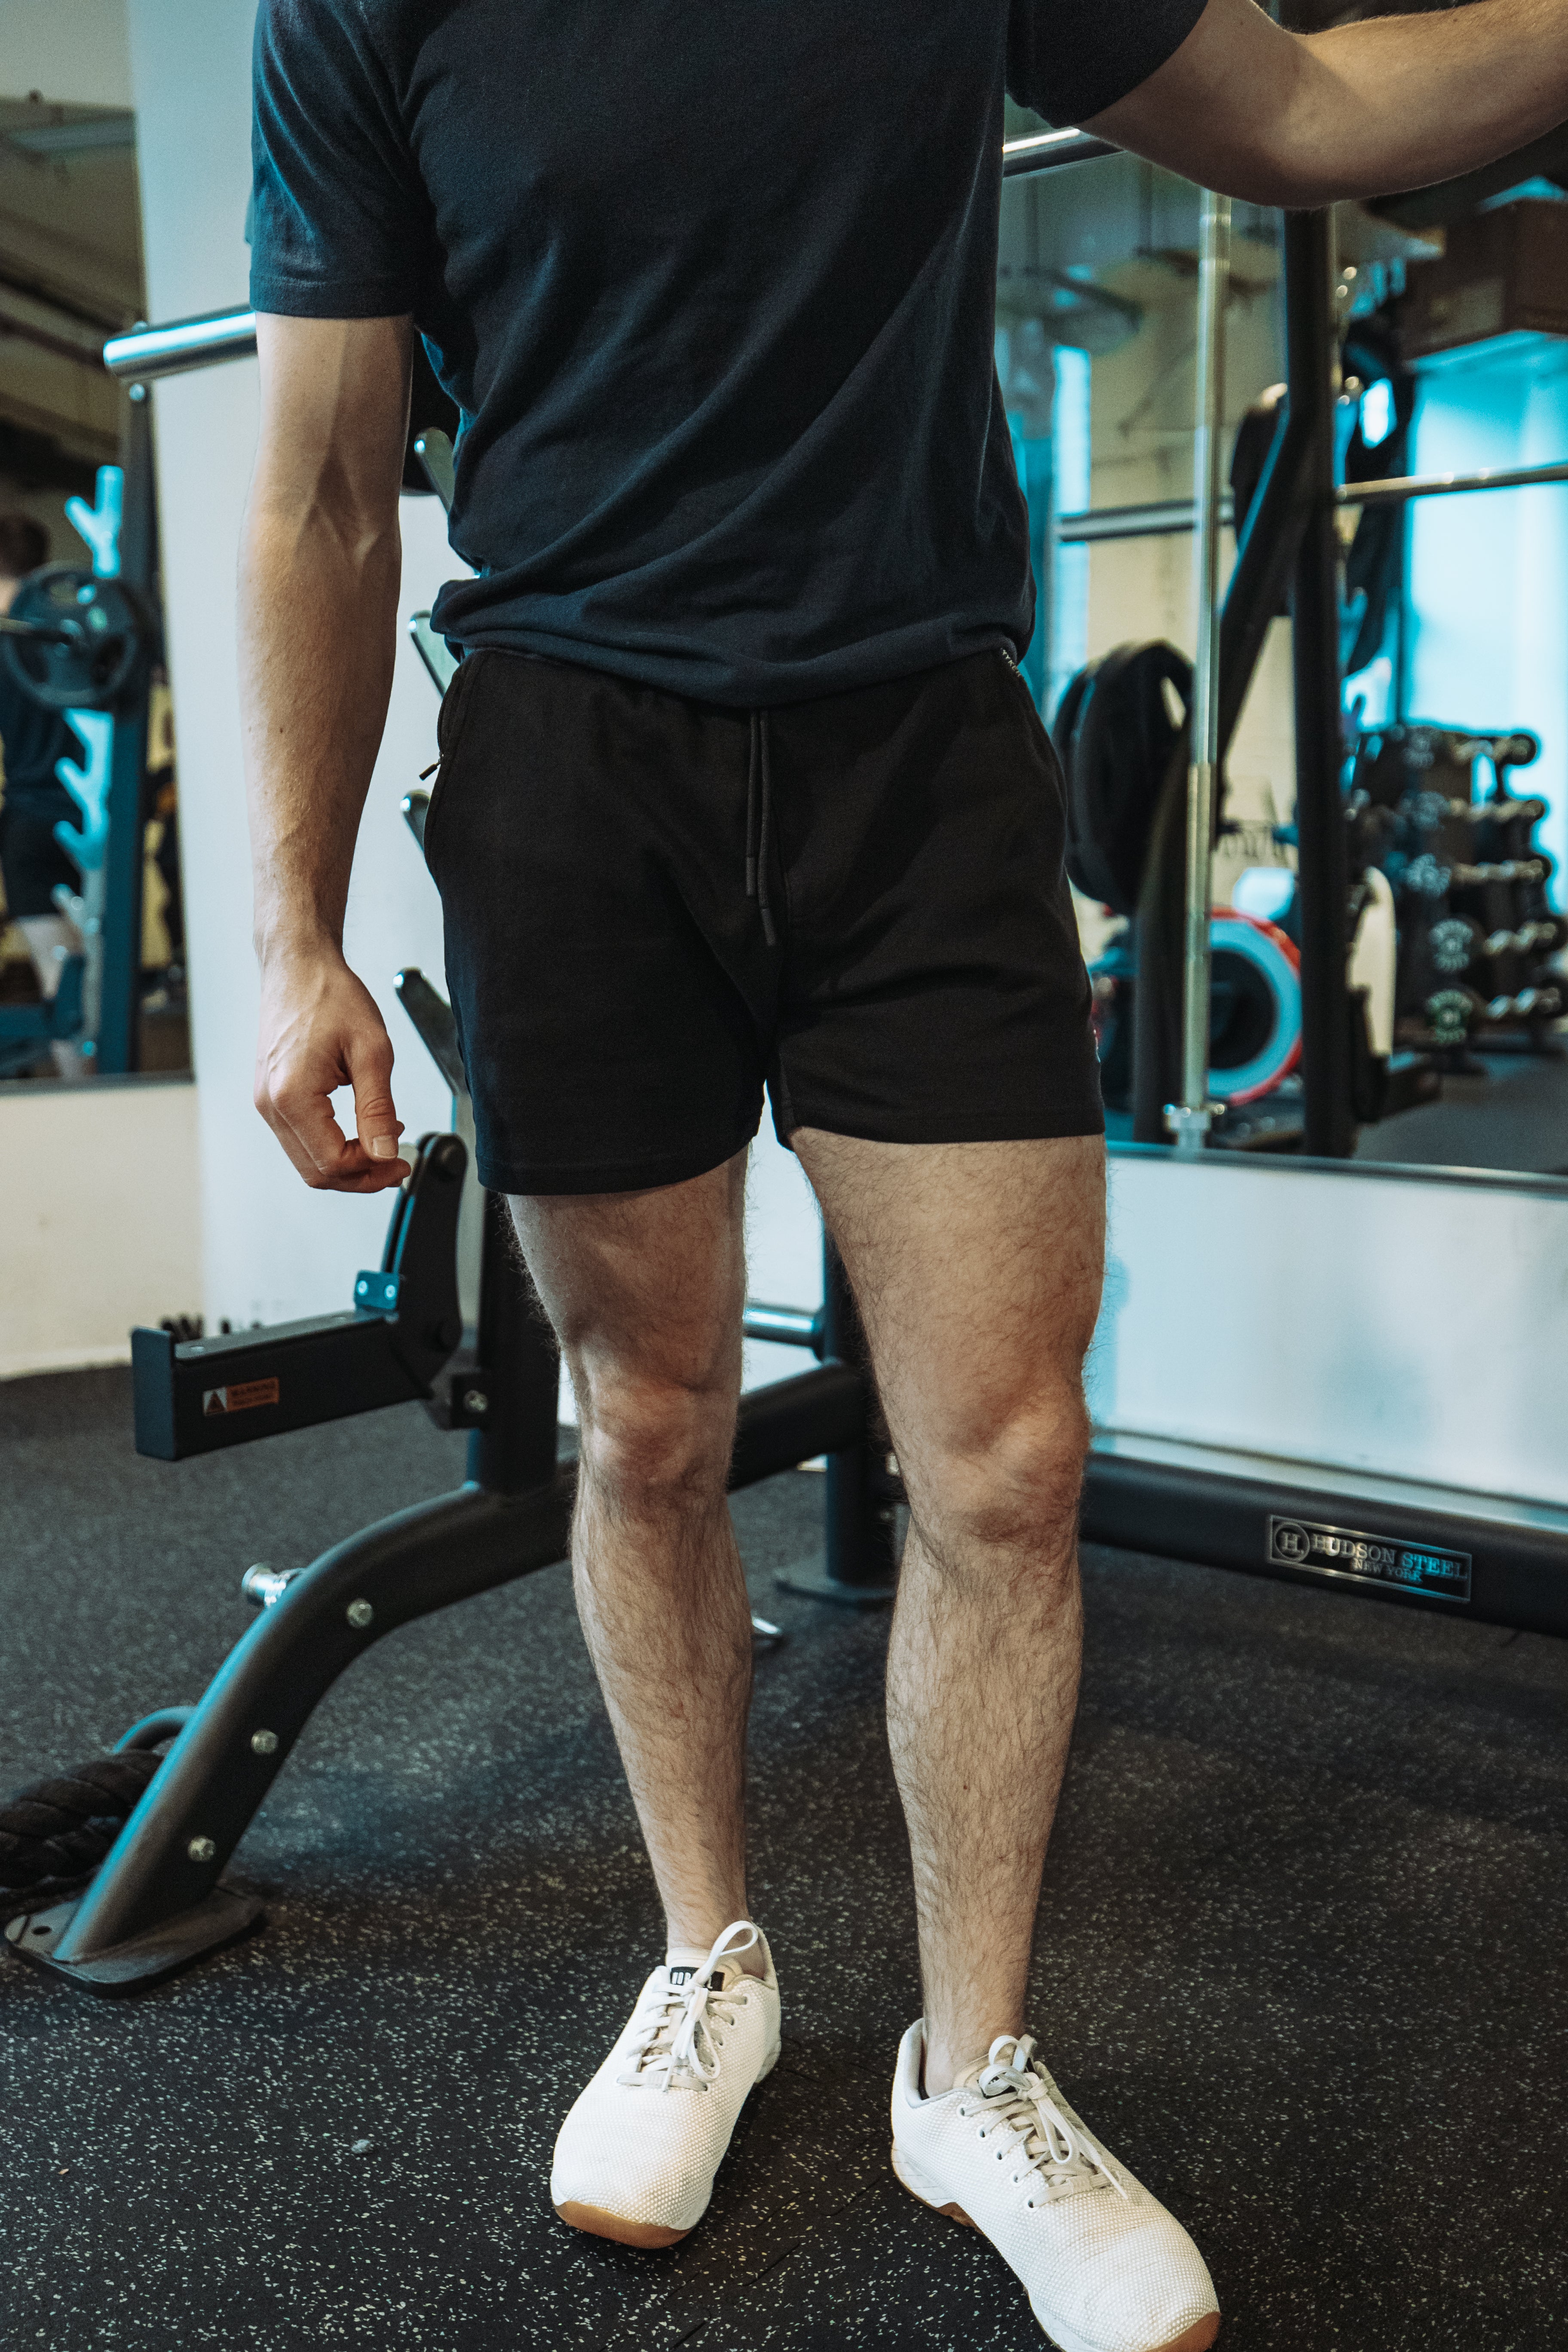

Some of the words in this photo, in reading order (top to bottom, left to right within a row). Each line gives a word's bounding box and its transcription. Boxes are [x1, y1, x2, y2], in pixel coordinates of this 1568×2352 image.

[1312, 1534, 1397, 1565] HUDSON
[1402, 1551, 1467, 1579] STEEL
[1352, 1557, 1382, 1575] NEW
[1385, 1564, 1422, 1584] YORK
